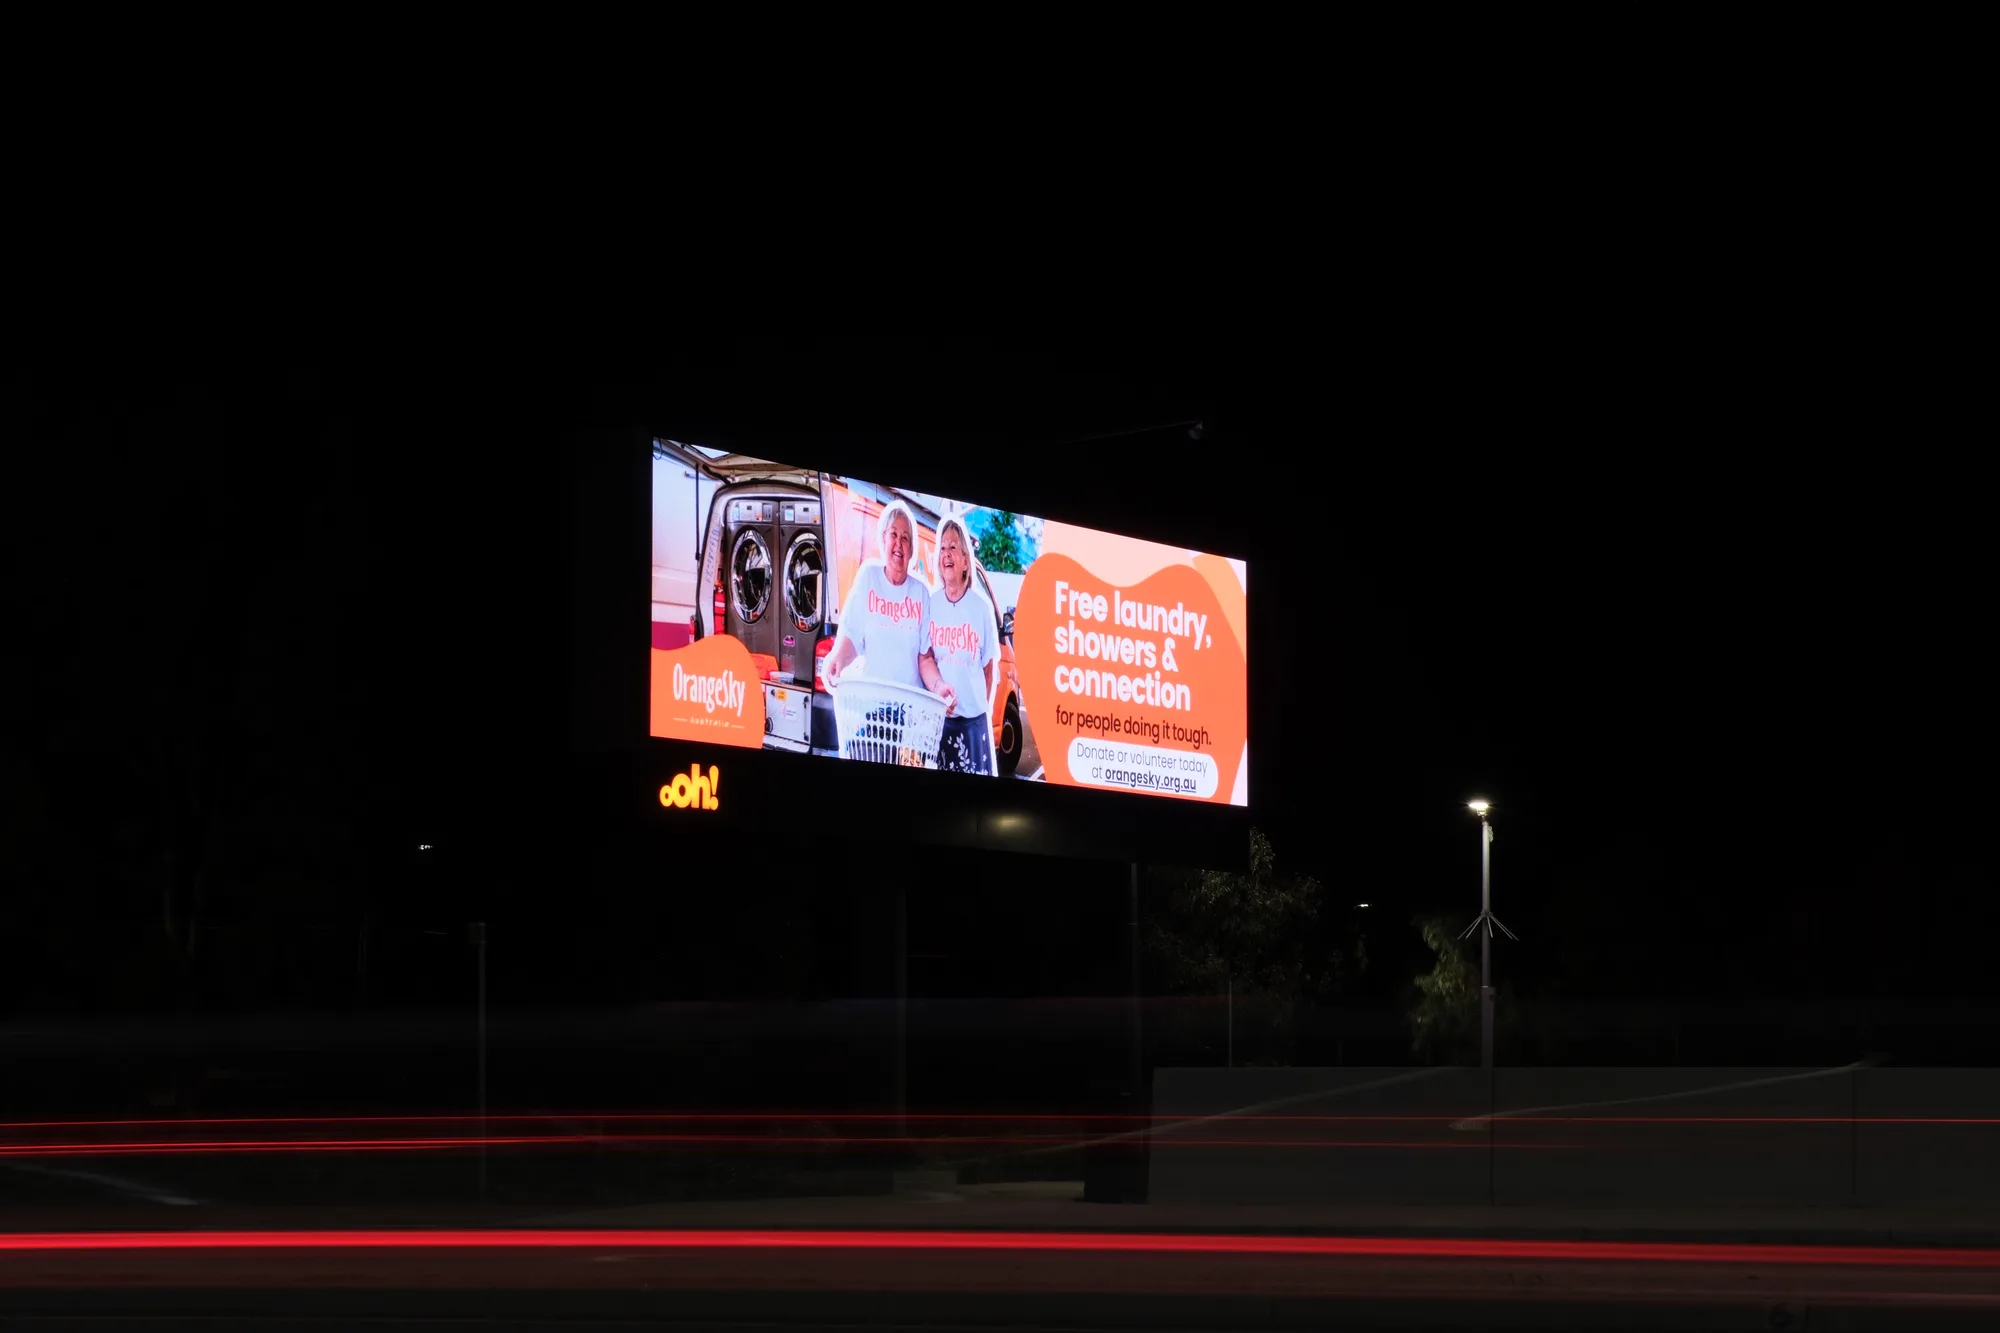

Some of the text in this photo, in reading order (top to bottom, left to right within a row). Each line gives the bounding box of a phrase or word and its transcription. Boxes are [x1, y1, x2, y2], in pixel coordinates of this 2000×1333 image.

[868, 588, 923, 625] OrangeSky
[1055, 580, 1212, 650] Free laundry,
[928, 620, 980, 661] OrangeSky
[1055, 620, 1178, 672] showers &
[673, 663, 745, 717] OrangeSky
[1055, 664, 1191, 711] connection
[1056, 704, 1212, 750] for people doing it tough.
[1077, 742, 1208, 778] Donate or volunteer today
[1092, 765, 1197, 793] at orangesky.org.au
